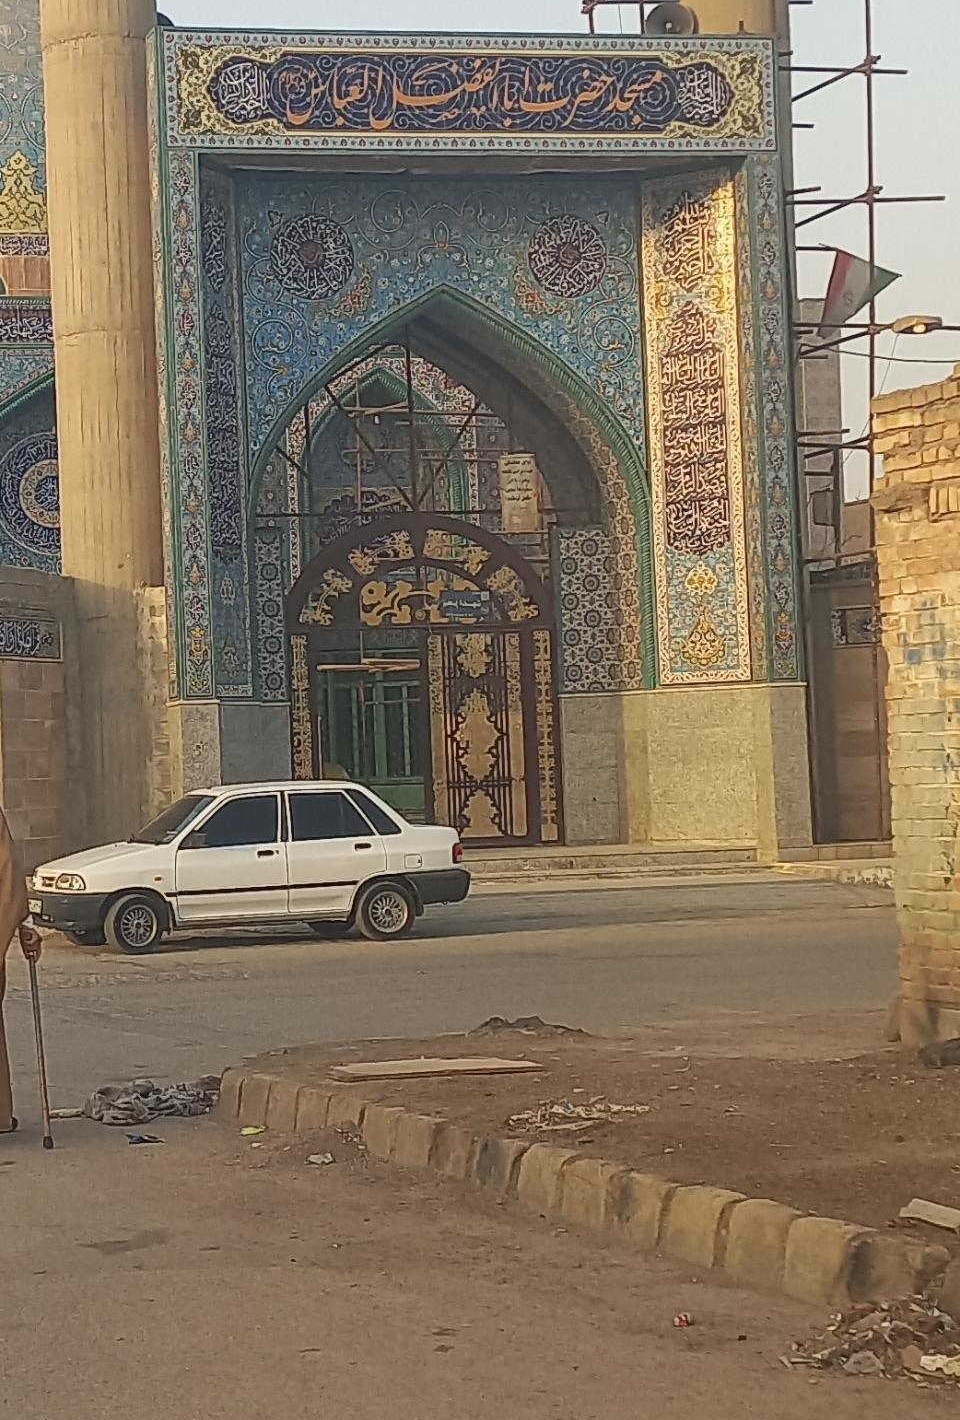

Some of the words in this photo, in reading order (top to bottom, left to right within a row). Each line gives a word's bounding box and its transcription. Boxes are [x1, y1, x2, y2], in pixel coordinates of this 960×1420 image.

[286, 64, 384, 127] العباس
[519, 68, 617, 128] حضرت
[603, 69, 664, 126] مسجد
